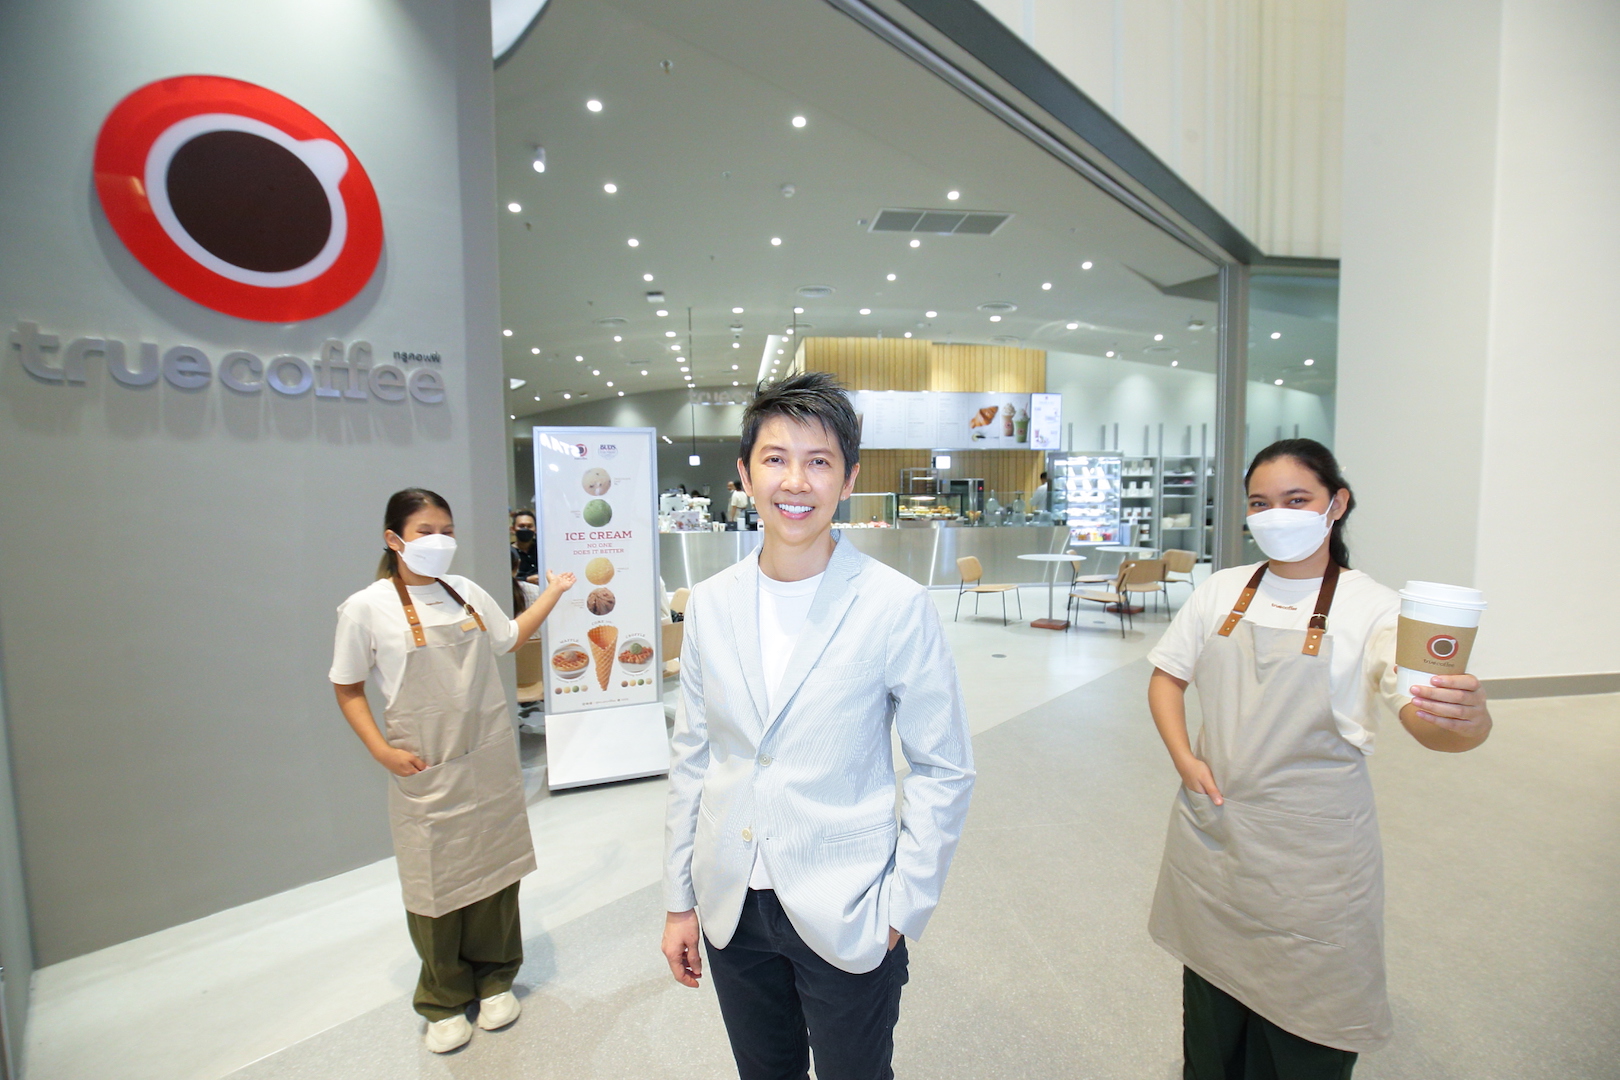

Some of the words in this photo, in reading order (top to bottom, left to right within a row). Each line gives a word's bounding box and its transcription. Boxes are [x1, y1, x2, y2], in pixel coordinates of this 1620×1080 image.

[11, 320, 446, 403] truecoffee
[565, 532, 586, 541] ICE
[589, 530, 632, 540] CREAM
